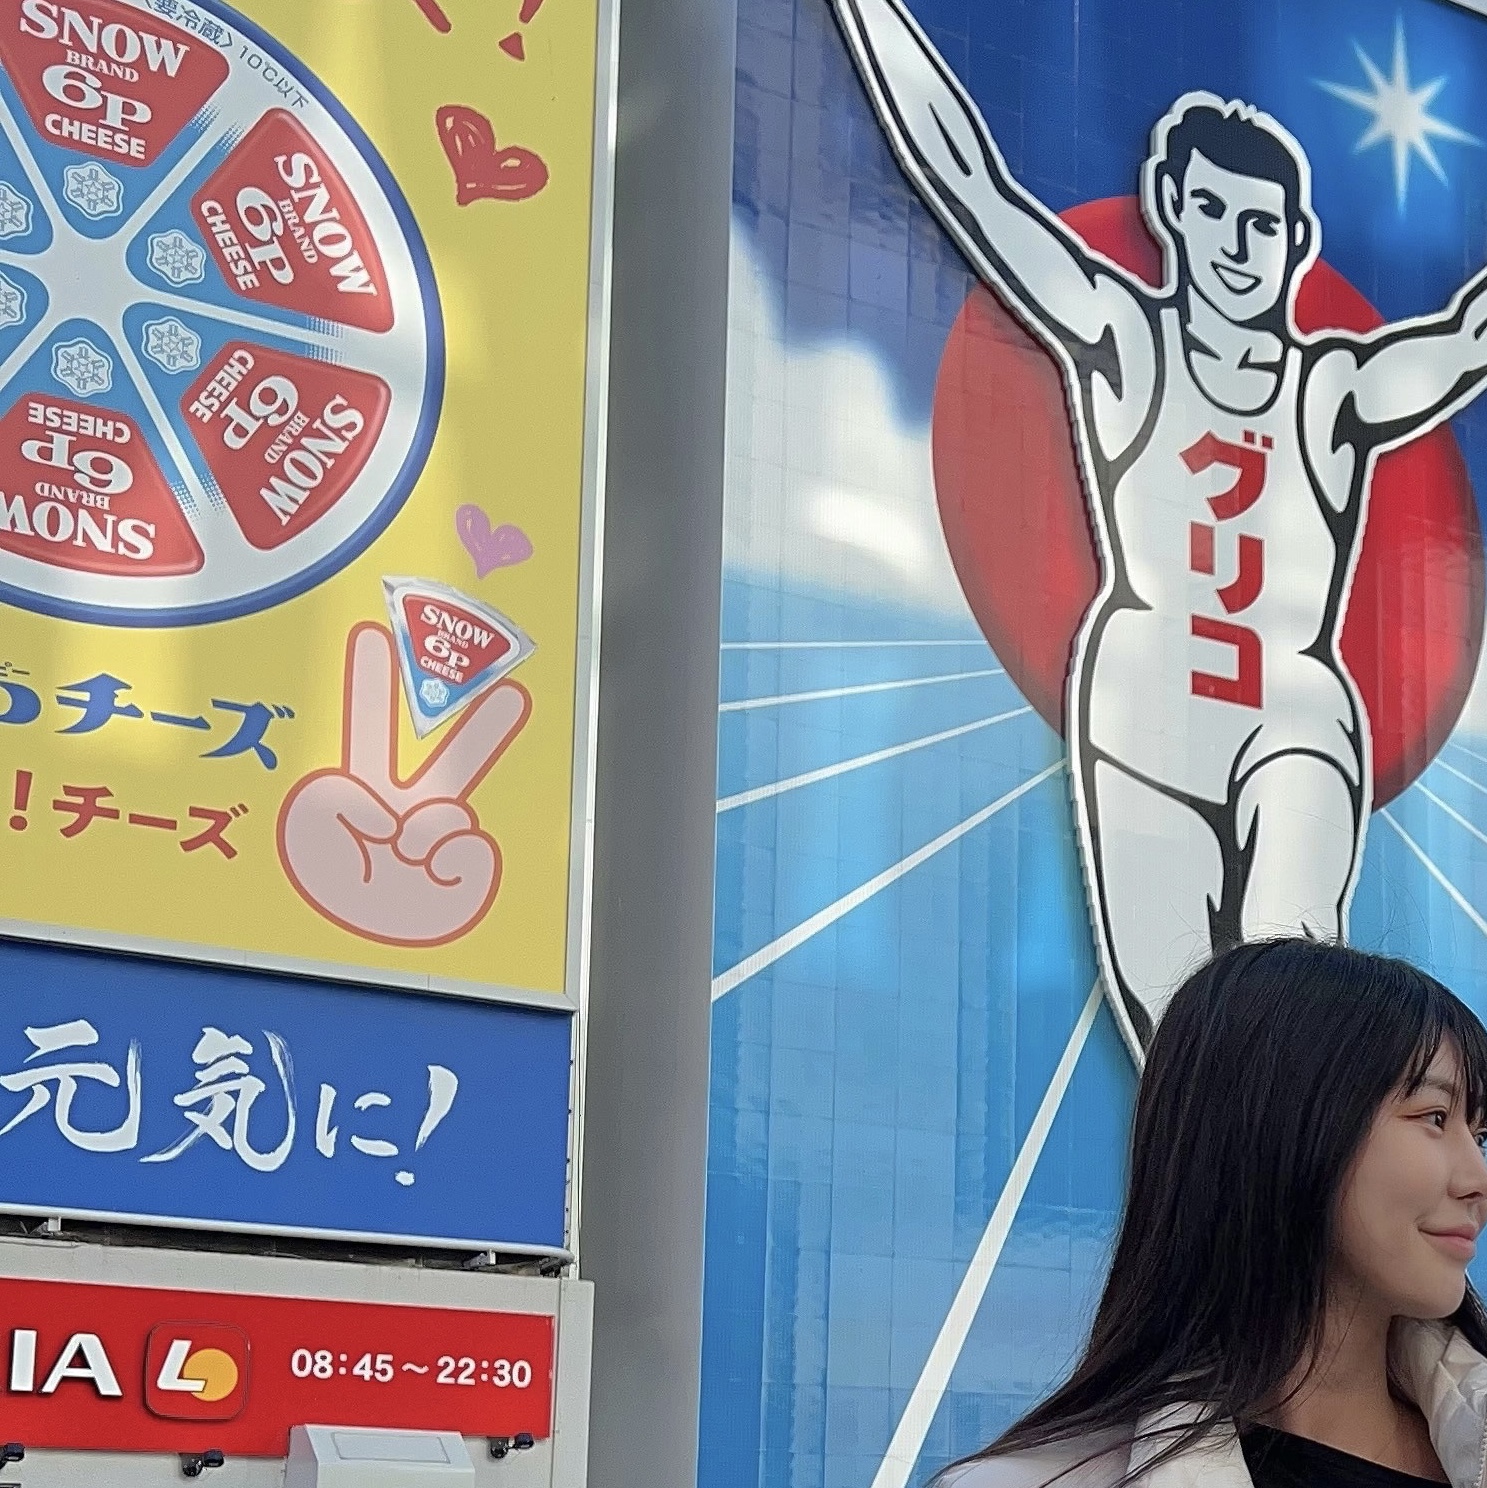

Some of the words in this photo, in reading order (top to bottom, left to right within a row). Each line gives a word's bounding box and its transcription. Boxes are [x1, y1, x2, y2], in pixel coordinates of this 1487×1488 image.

[20, 0, 190, 77] SNOW
[66, 49, 139, 83] BRAND
[42, 64, 152, 131] 6P
[44, 113, 146, 160] CHEESE
[201, 200, 260, 291] CHEESE
[236, 186, 295, 285] 6P
[274, 152, 378, 296] SNOW
[278, 198, 318, 264] BRAND
[188, 349, 255, 424] CHEESE
[220, 374, 299, 450] 6P
[28, 401, 131, 444] CHEESE
[264, 411, 310, 464] BRAND
[21, 430, 134, 495] 6P
[259, 394, 365, 526] SNOW
[34, 481, 111, 511] BRAND
[1179, 429, 1274, 709] グリコ
[420, 604, 495, 649] SNOW
[424, 634, 470, 669] 6P
[420, 655, 464, 683] CHEESE
[0, 1019, 458, 1186] 元気に!
[10, 1329, 123, 1397] IA
